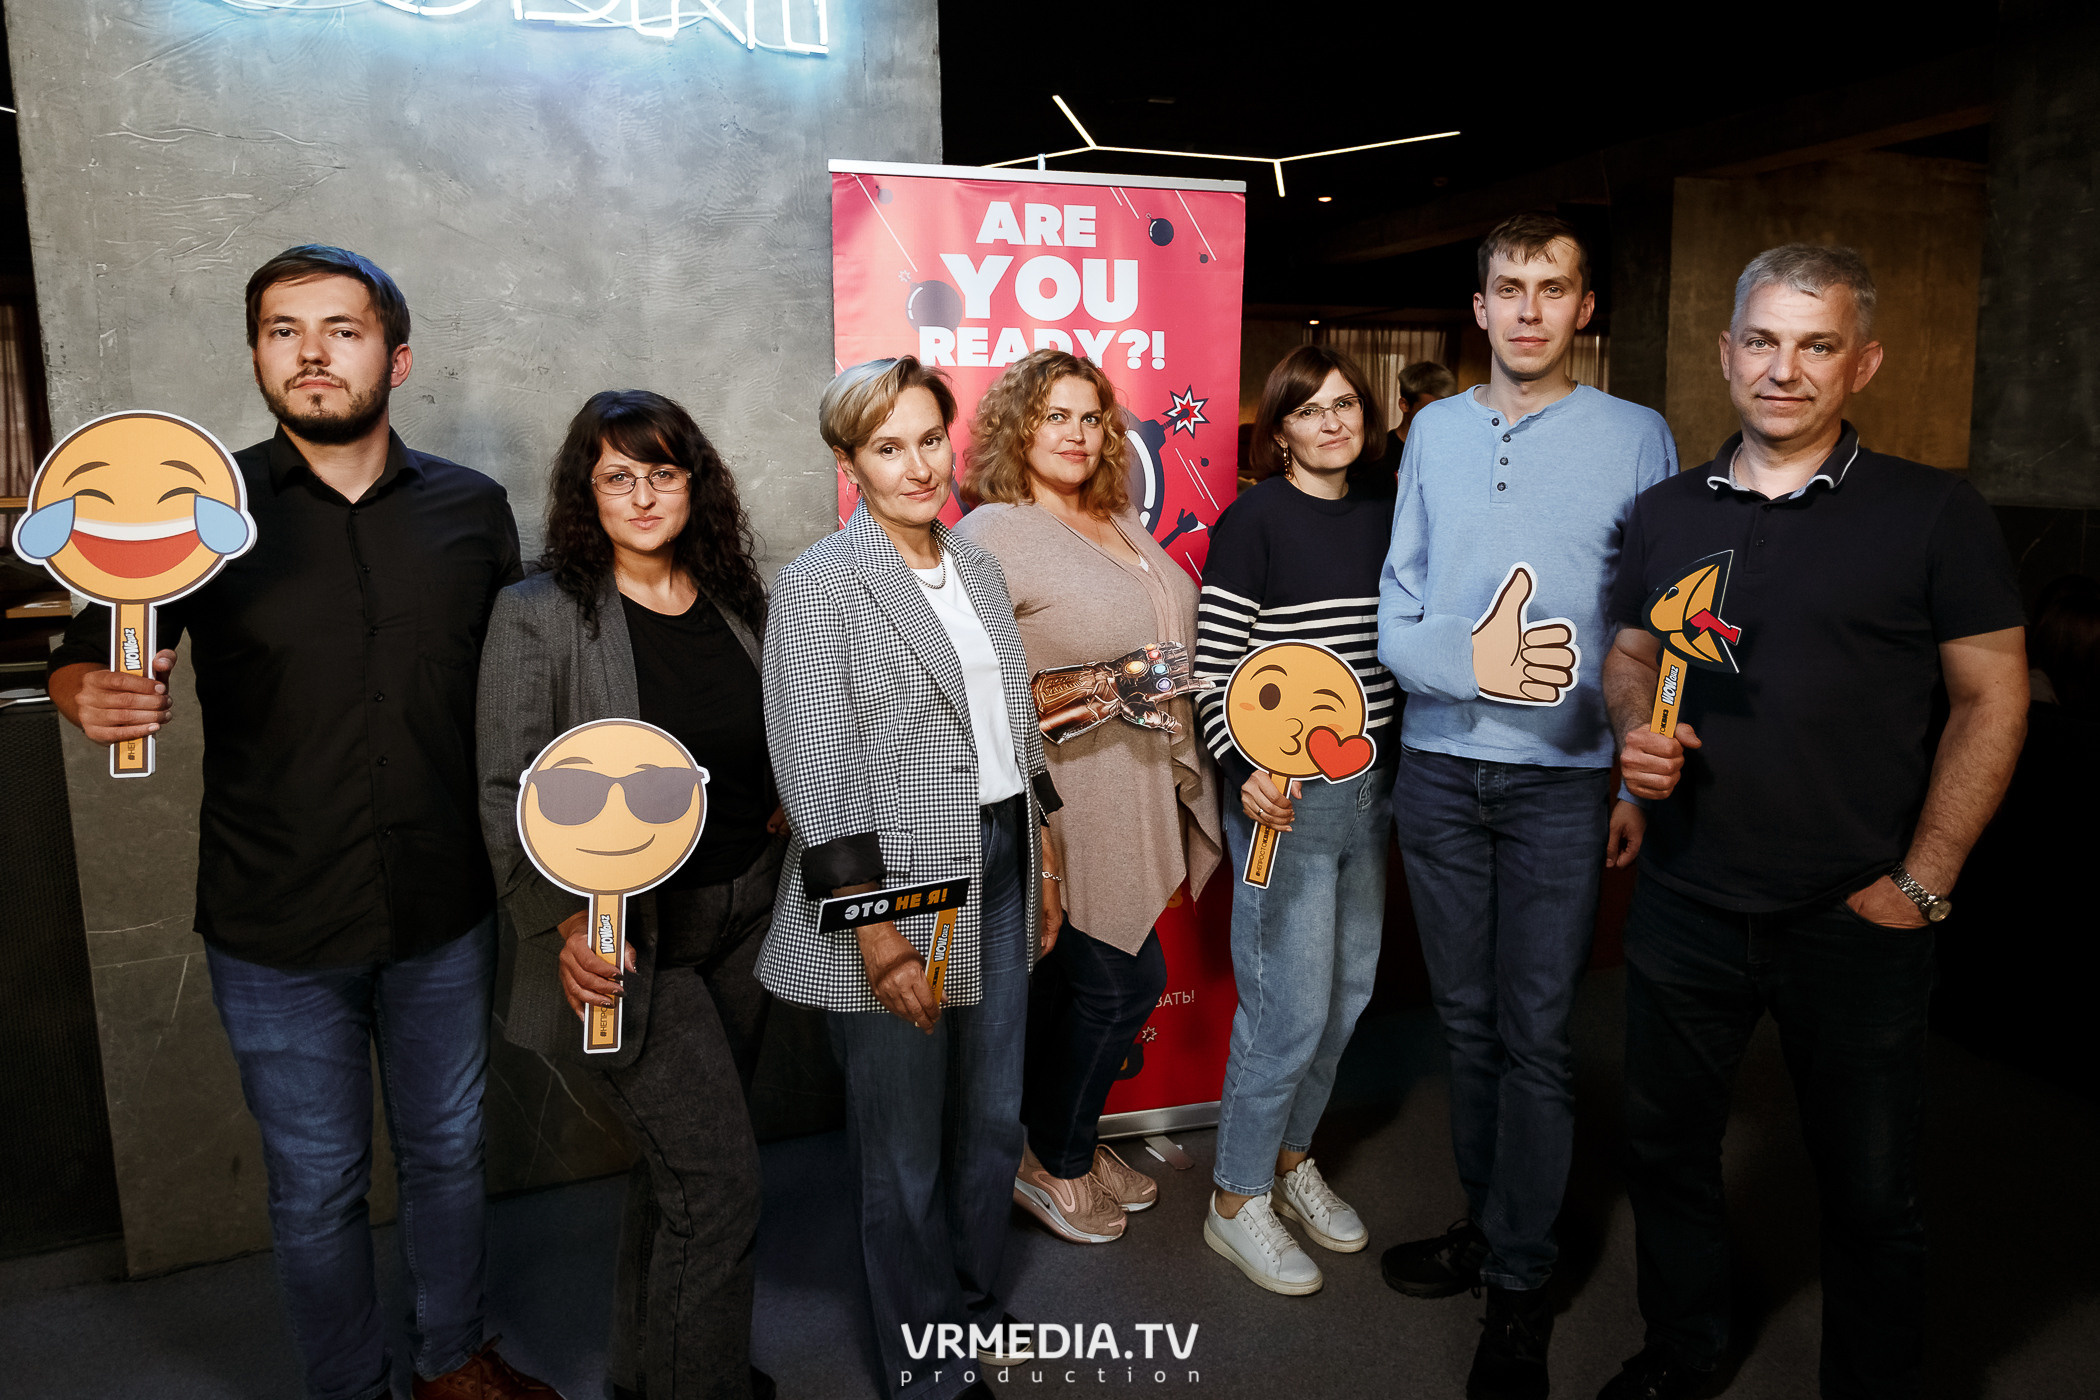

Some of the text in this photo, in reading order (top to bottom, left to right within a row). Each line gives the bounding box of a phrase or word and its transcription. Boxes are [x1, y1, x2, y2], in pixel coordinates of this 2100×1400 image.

[976, 201, 1097, 248] ARE
[940, 253, 1139, 323] YOU
[919, 326, 1166, 370] READY?!
[844, 888, 948, 920] ЭТО НЕ Я!
